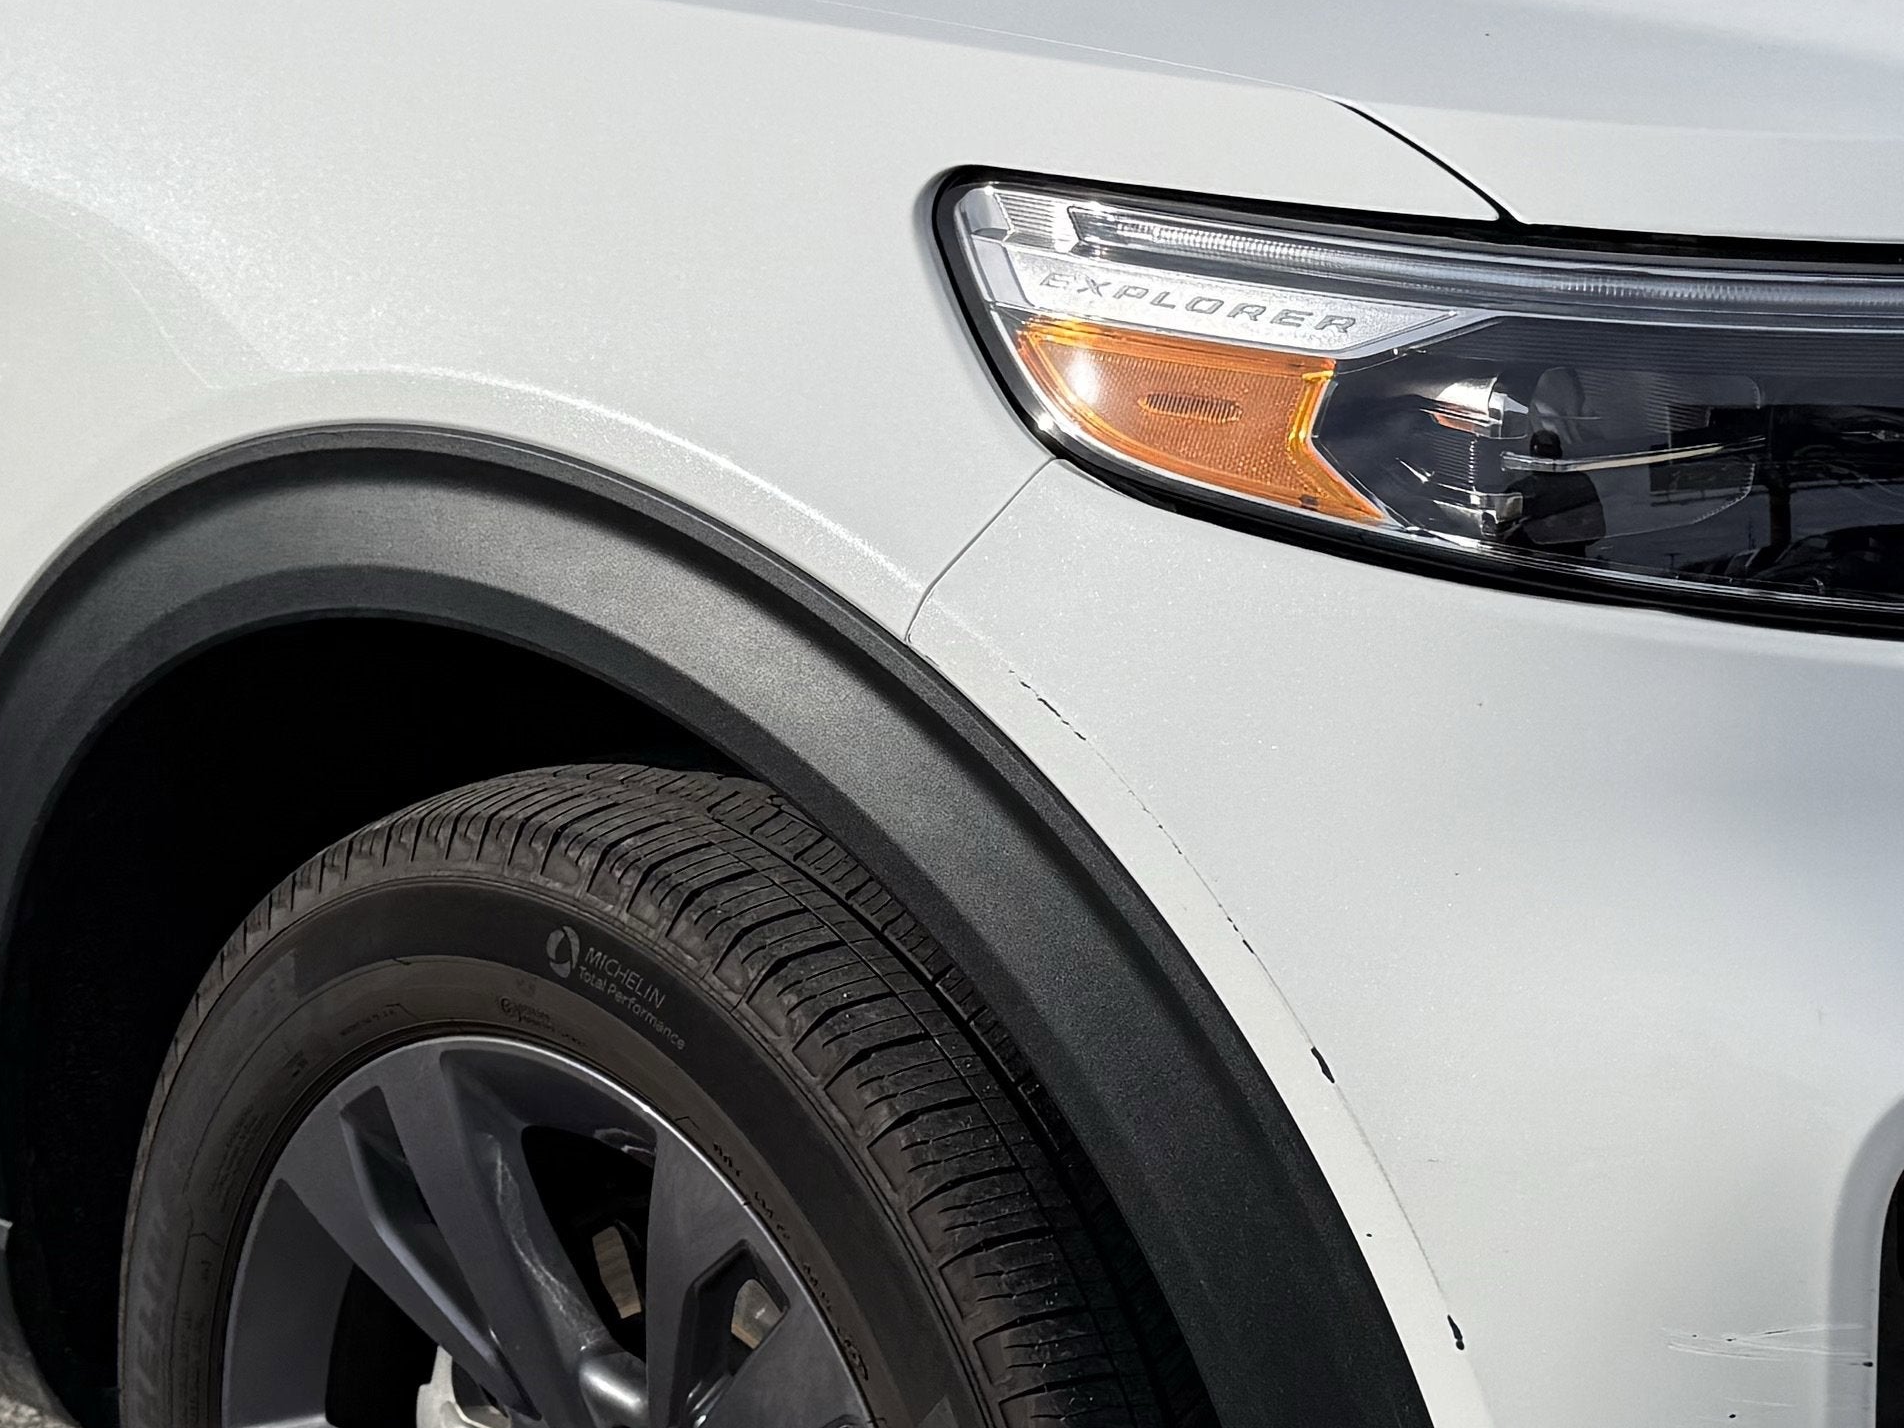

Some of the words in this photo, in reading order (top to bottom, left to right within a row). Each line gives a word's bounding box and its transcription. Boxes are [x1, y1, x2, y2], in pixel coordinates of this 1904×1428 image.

[1039, 272, 1358, 334] EXPLORER
[579, 965, 608, 992] Total
[607, 983, 686, 1050] Performance
[584, 947, 666, 1009] MICHELIN
